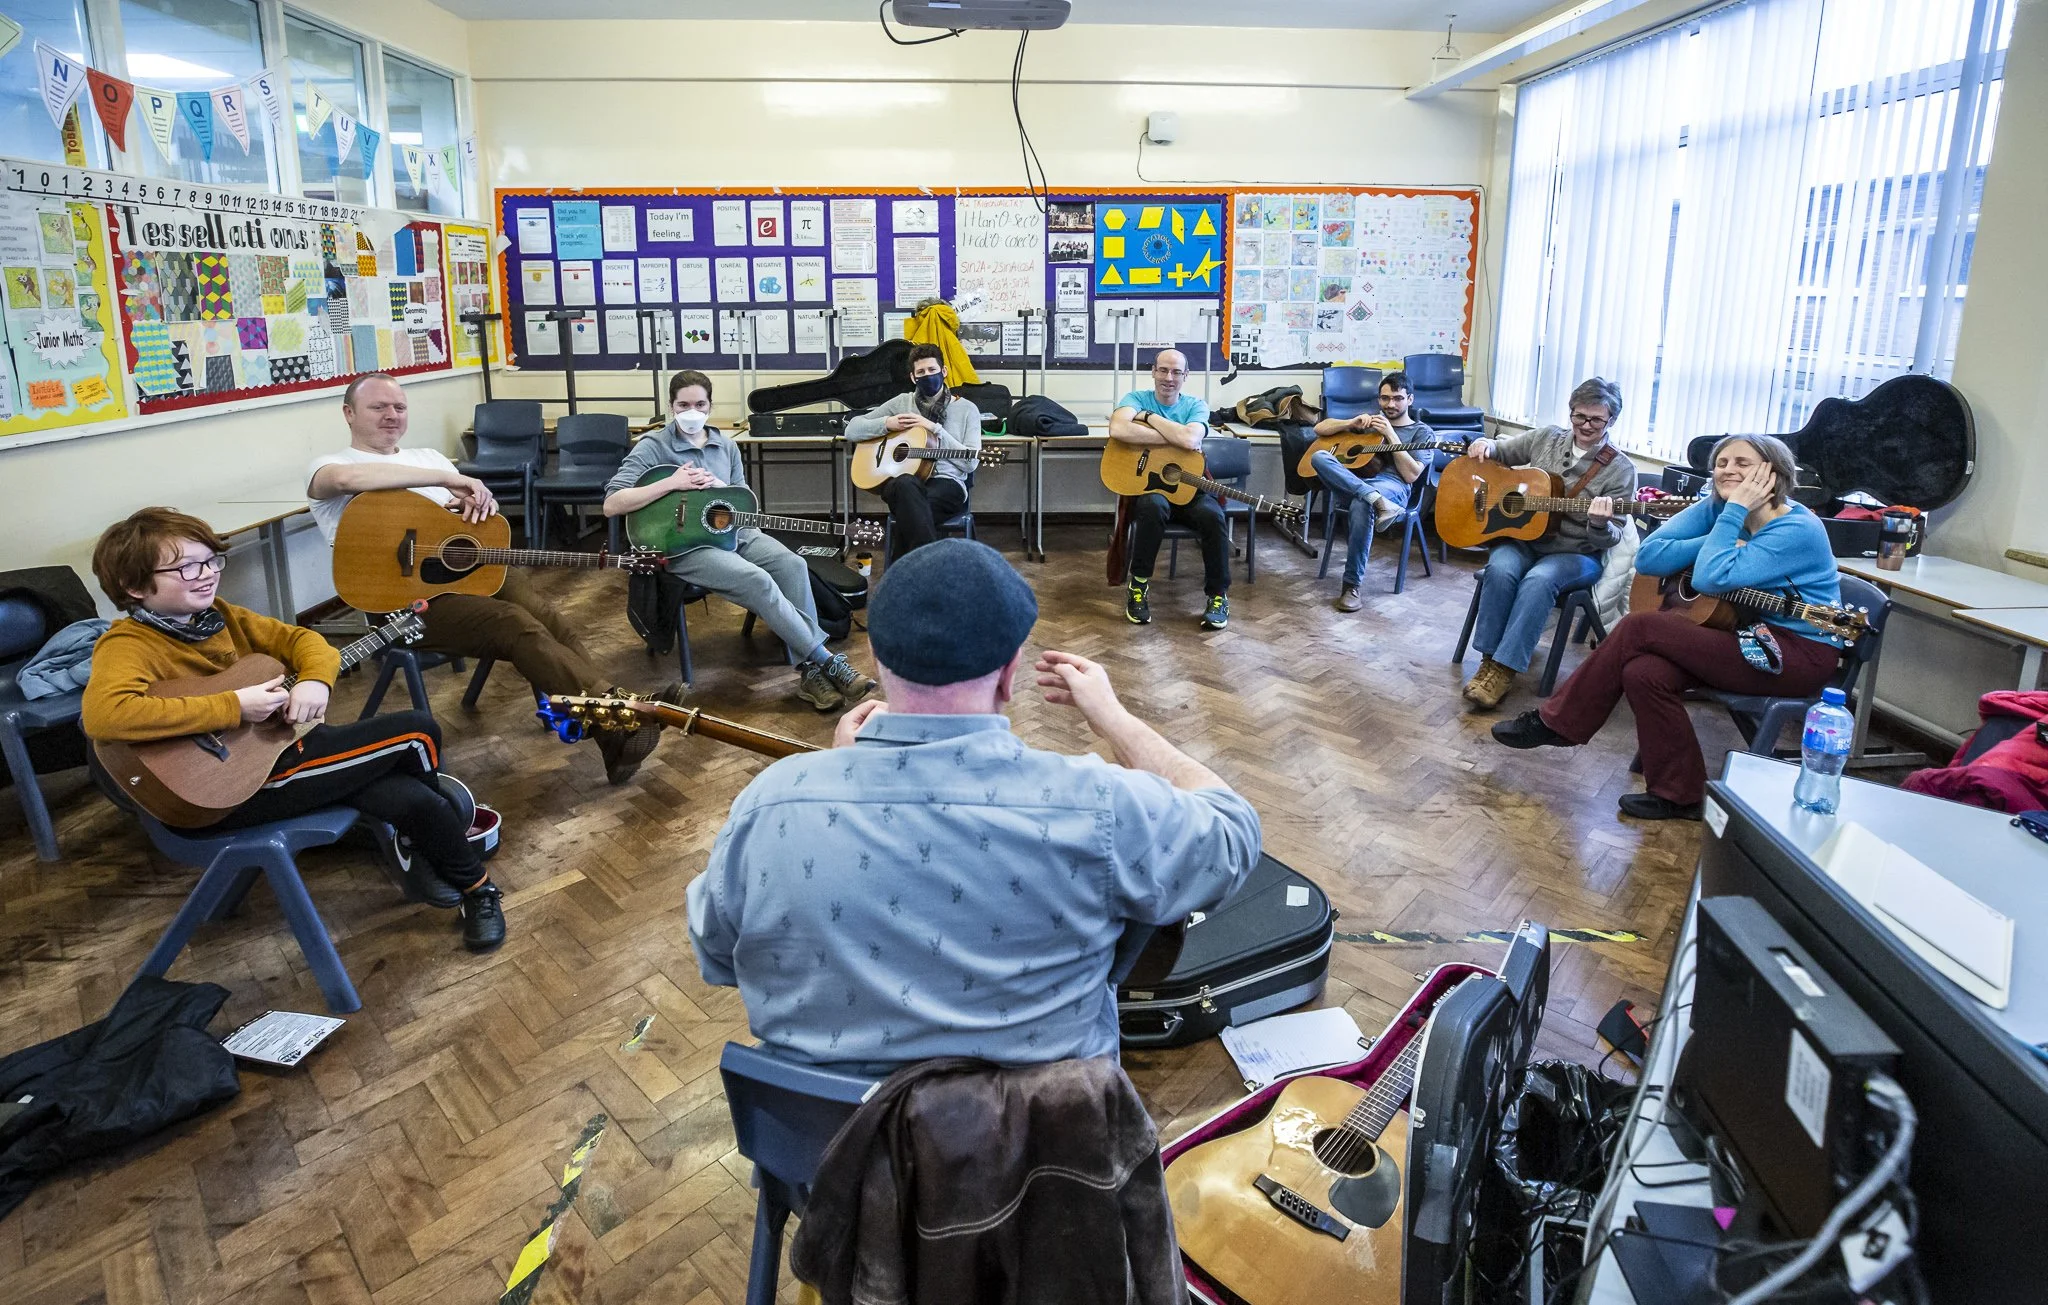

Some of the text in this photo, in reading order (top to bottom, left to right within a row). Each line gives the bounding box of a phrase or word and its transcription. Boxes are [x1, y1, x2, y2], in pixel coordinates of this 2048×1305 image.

[53, 58, 68, 82] N
[103, 84, 118, 103] O
[260, 79, 271, 95] S
[151, 97, 162, 114] P
[222, 95, 236, 112] R
[314, 93, 322, 107] T
[189, 100, 204, 119] Q
[340, 116, 349, 131] U
[363, 132, 371, 146] V
[465, 142, 473, 153] Z
[408, 151, 417, 164] W
[428, 154, 435, 166] X
[443, 152, 449, 163] Y
[41, 172, 50, 186] 0
[62, 175, 68, 188] 1
[83, 177, 93, 191] 2
[105, 180, 112, 193] 3
[122, 182, 129, 195] 4
[139, 185, 147, 197] 5
[157, 187, 164, 199] 6
[174, 189, 181, 201] 7
[189, 191, 197, 203] 8
[205, 193, 212, 204] 9
[219, 194, 230, 206] 10
[232, 196, 241, 207] 11
[246, 197, 256, 209] 12
[259, 199, 268, 210] 13
[272, 200, 281, 211] 14
[285, 202, 294, 213] 15
[298, 203, 305, 214] 16
[309, 205, 317, 215] 17
[320, 206, 328, 216] 18
[331, 207, 338, 217] 19
[341, 208, 348, 218] 20
[350, 209, 357, 219] 21
[649, 212, 689, 221] Today I'm
[652, 229, 681, 239] feeling
[760, 220, 773, 236] e
[36, 329, 84, 349] Junior Maths
